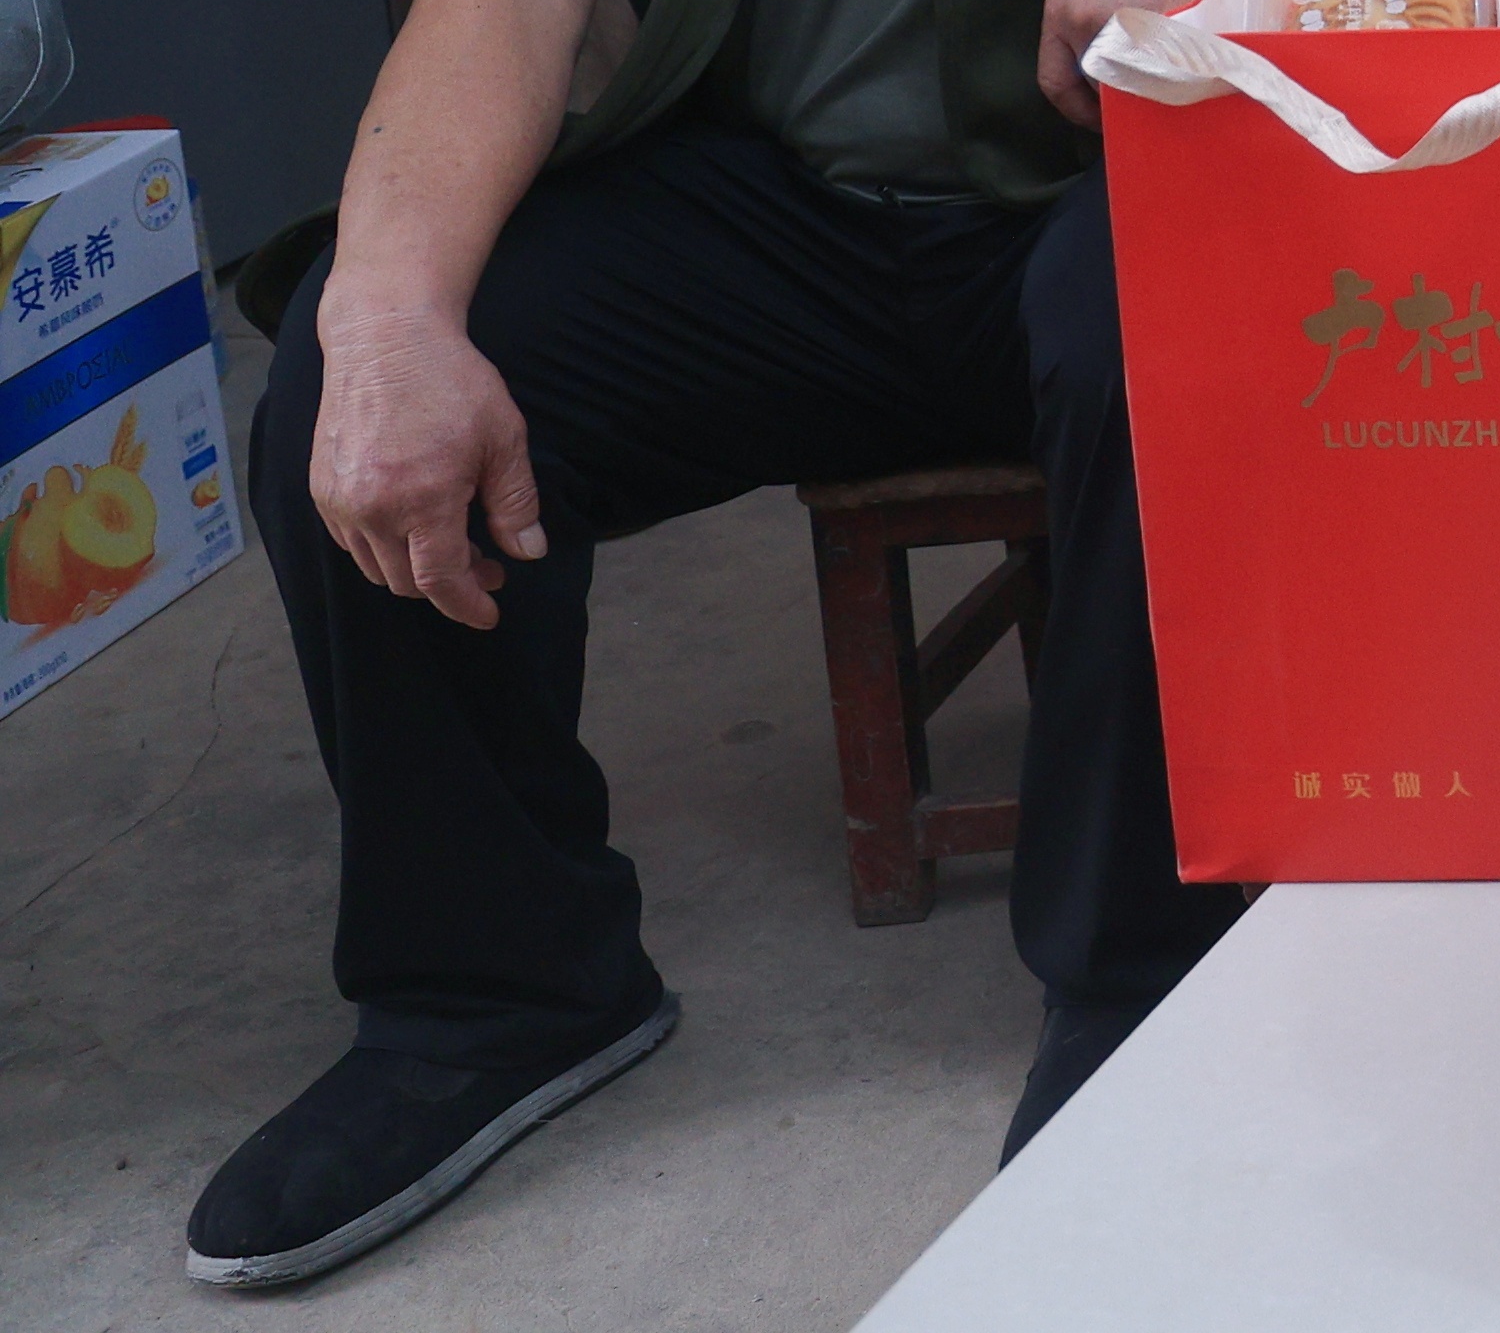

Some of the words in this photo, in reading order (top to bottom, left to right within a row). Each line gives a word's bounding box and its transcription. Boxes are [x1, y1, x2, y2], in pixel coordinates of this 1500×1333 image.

[12, 224, 115, 323] 安慕希
[1293, 770, 1473, 800] 诚实做人
